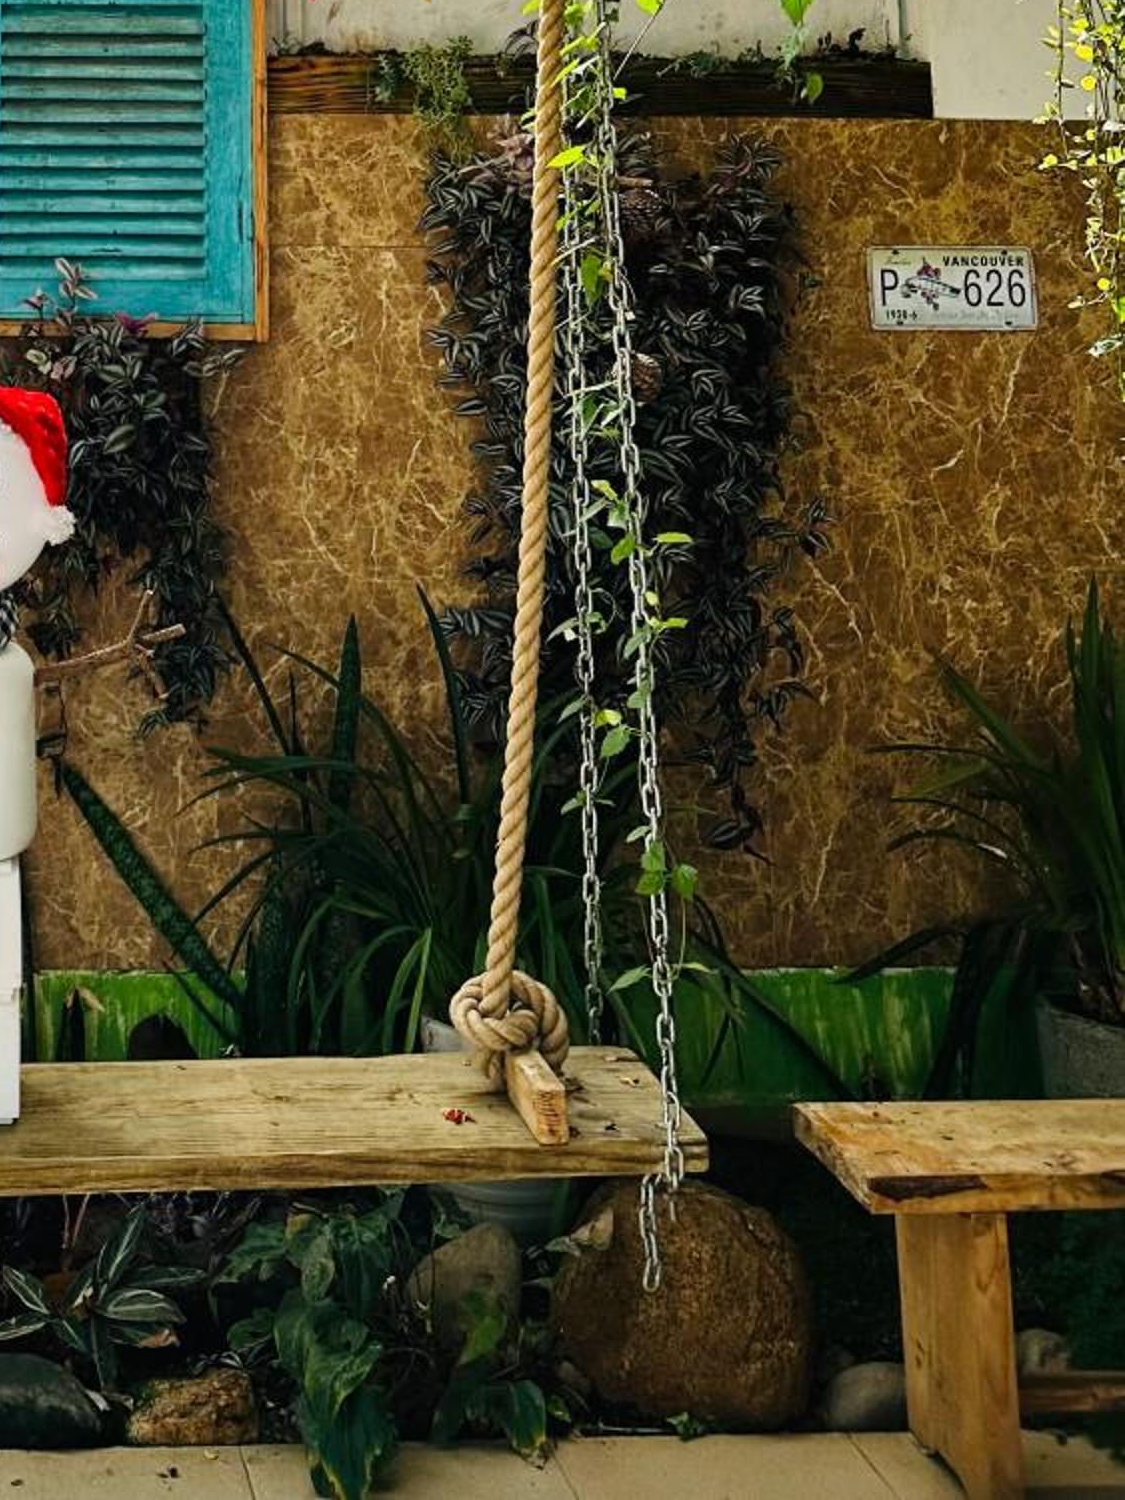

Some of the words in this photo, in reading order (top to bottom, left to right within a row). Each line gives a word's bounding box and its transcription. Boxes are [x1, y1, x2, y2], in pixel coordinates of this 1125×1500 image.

[942, 255, 1024, 267] VANCOUVER
[880, 269, 899, 306] P
[964, 269, 1026, 307] 626
